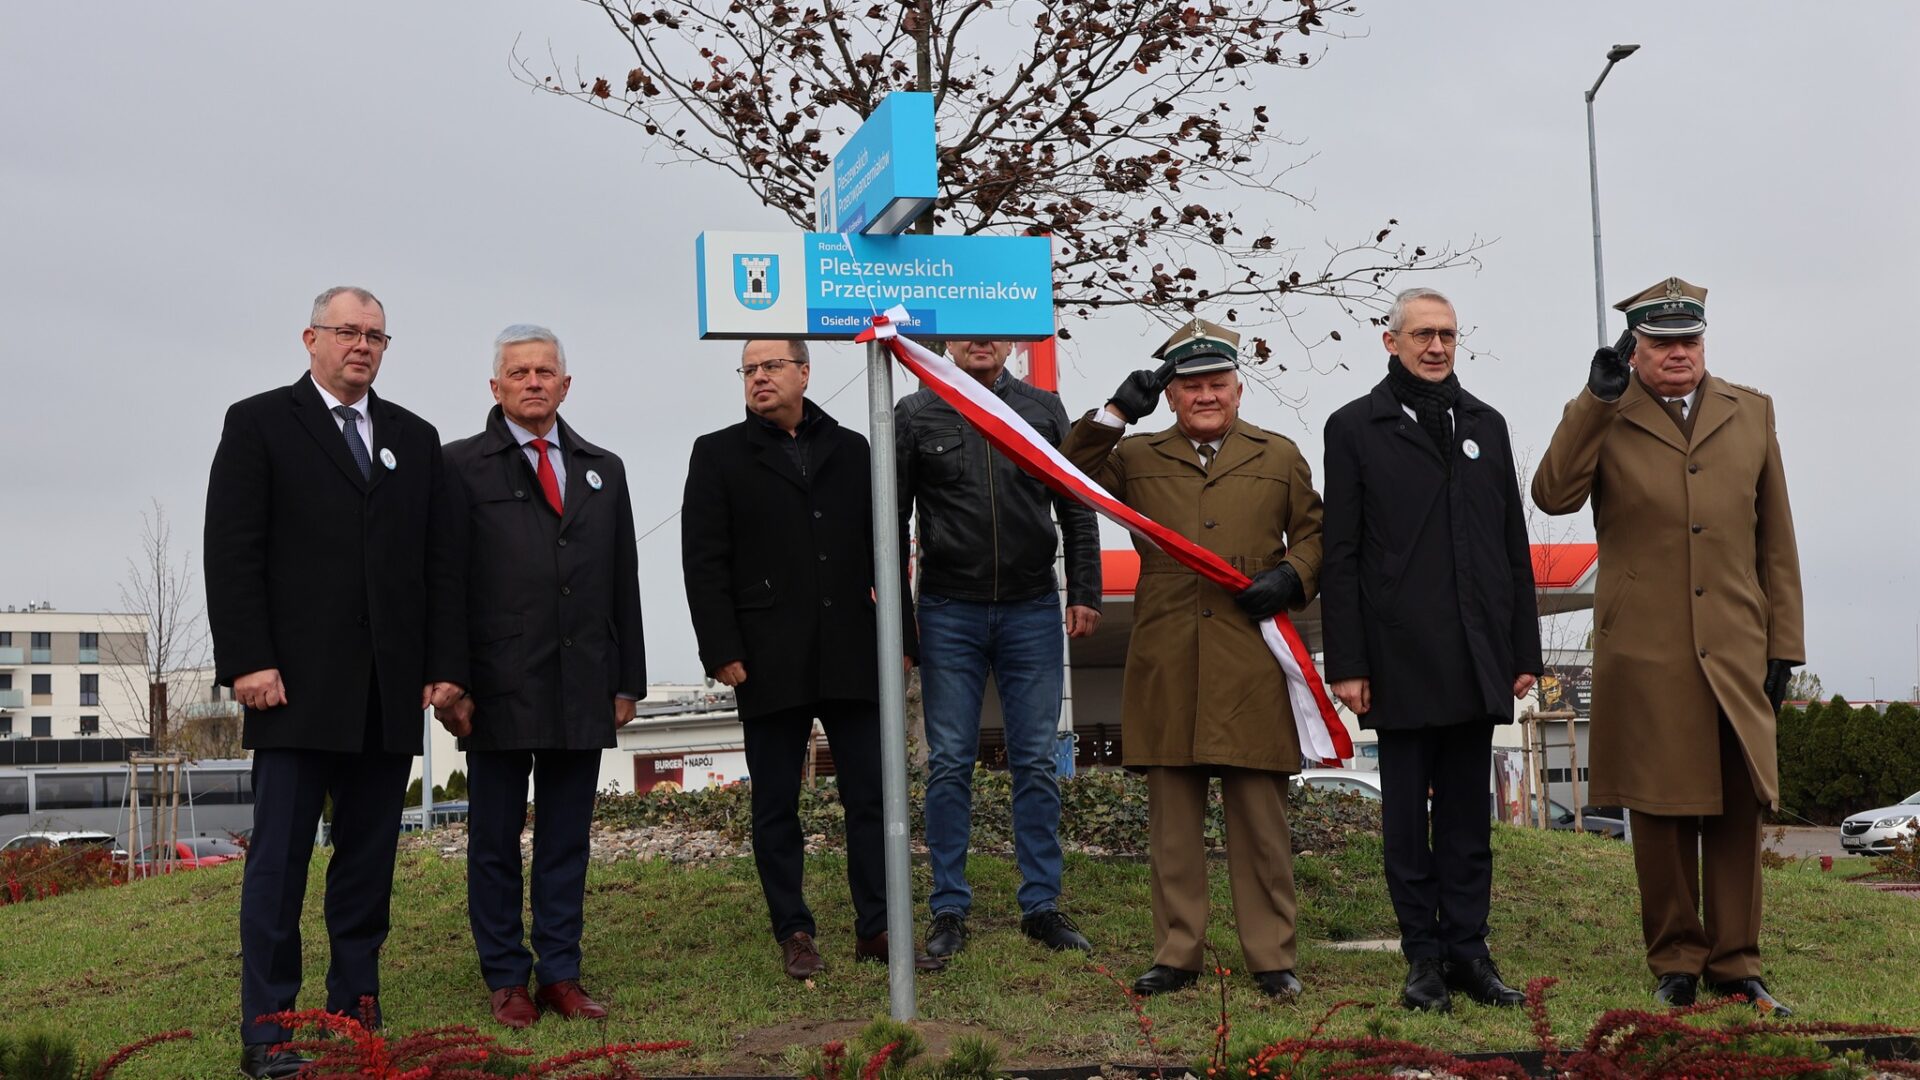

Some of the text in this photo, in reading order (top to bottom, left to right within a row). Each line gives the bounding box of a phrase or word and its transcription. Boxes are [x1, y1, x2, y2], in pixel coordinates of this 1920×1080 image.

[818, 242, 848, 251] Rondo
[820, 258, 954, 277] Pleszewskich
[821, 280, 1038, 302] Przeciwpancerniaków
[821, 316, 860, 326] Osiedle
[654, 759, 683, 770] BURGER
